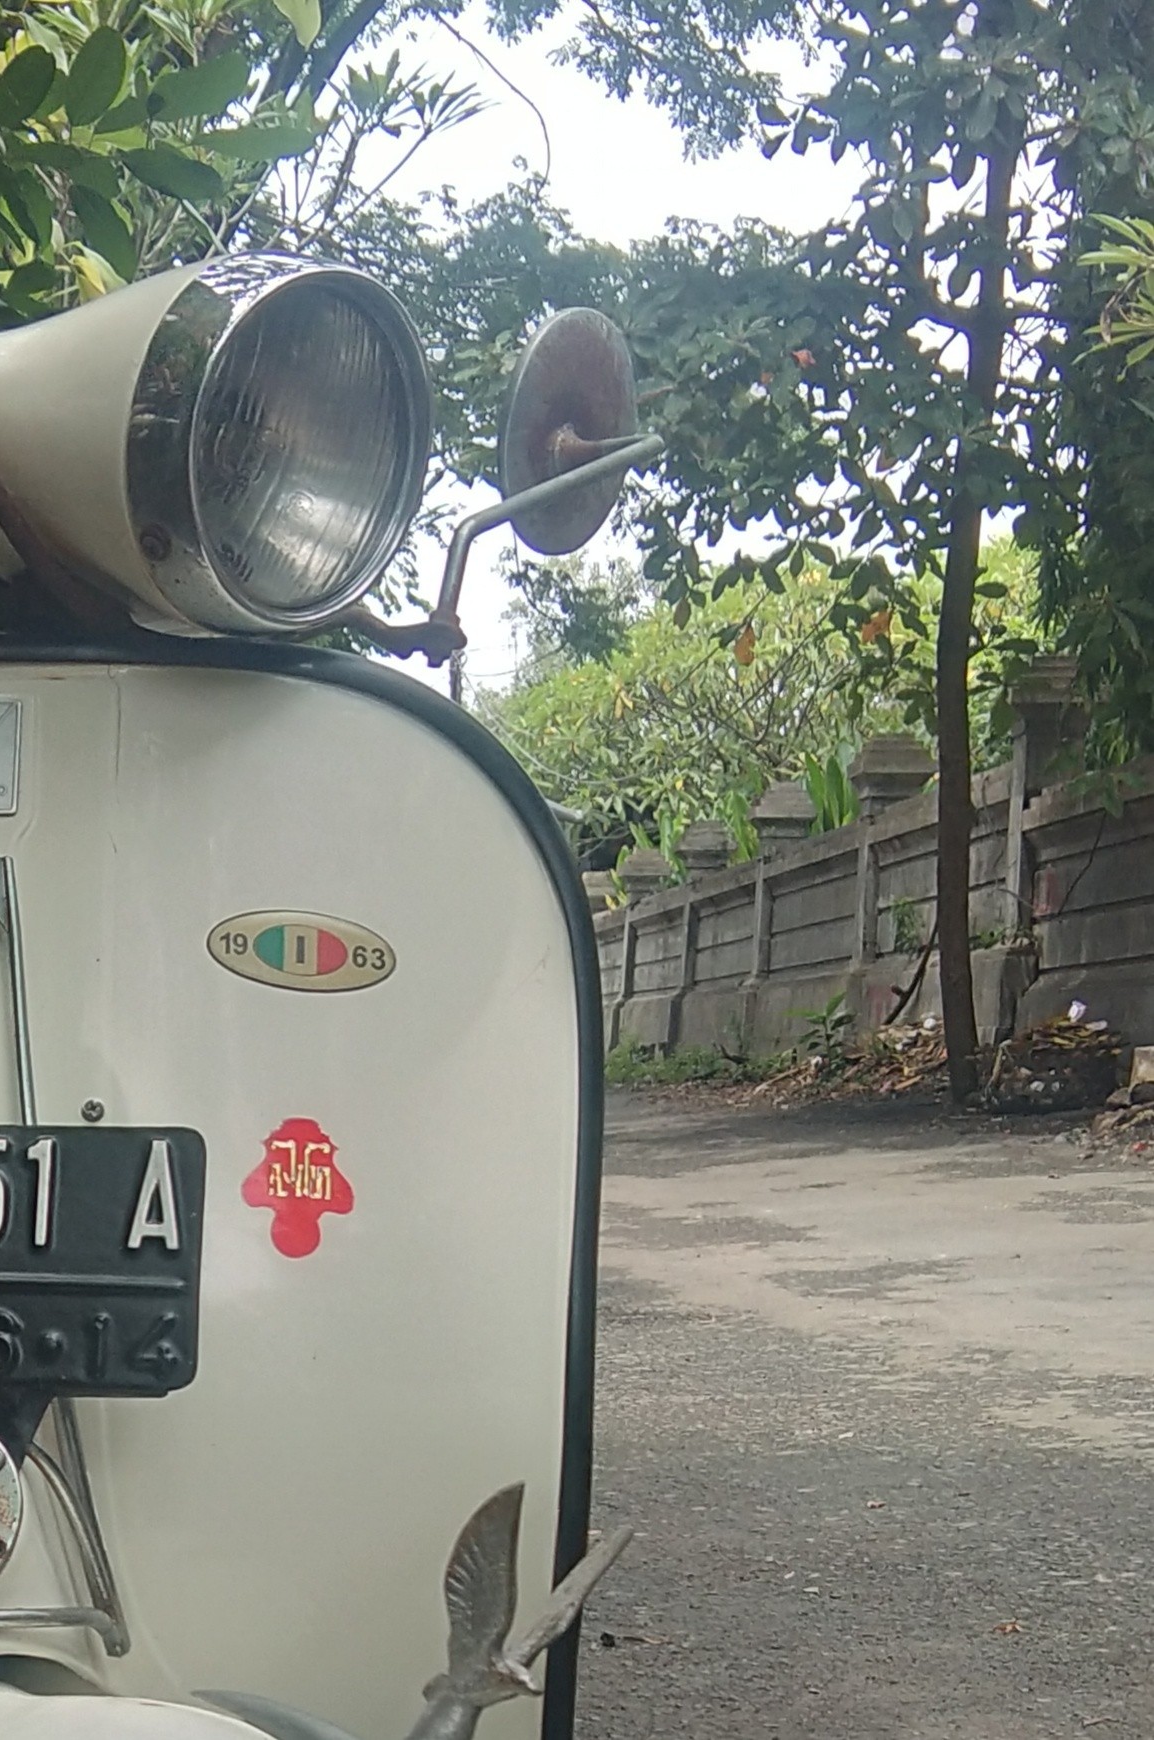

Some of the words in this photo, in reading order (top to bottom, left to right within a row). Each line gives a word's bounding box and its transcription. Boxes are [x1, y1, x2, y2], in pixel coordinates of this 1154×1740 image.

[219, 932, 248, 955] 19
[352, 945, 386, 970] 63
[127, 1139, 180, 1250] A
